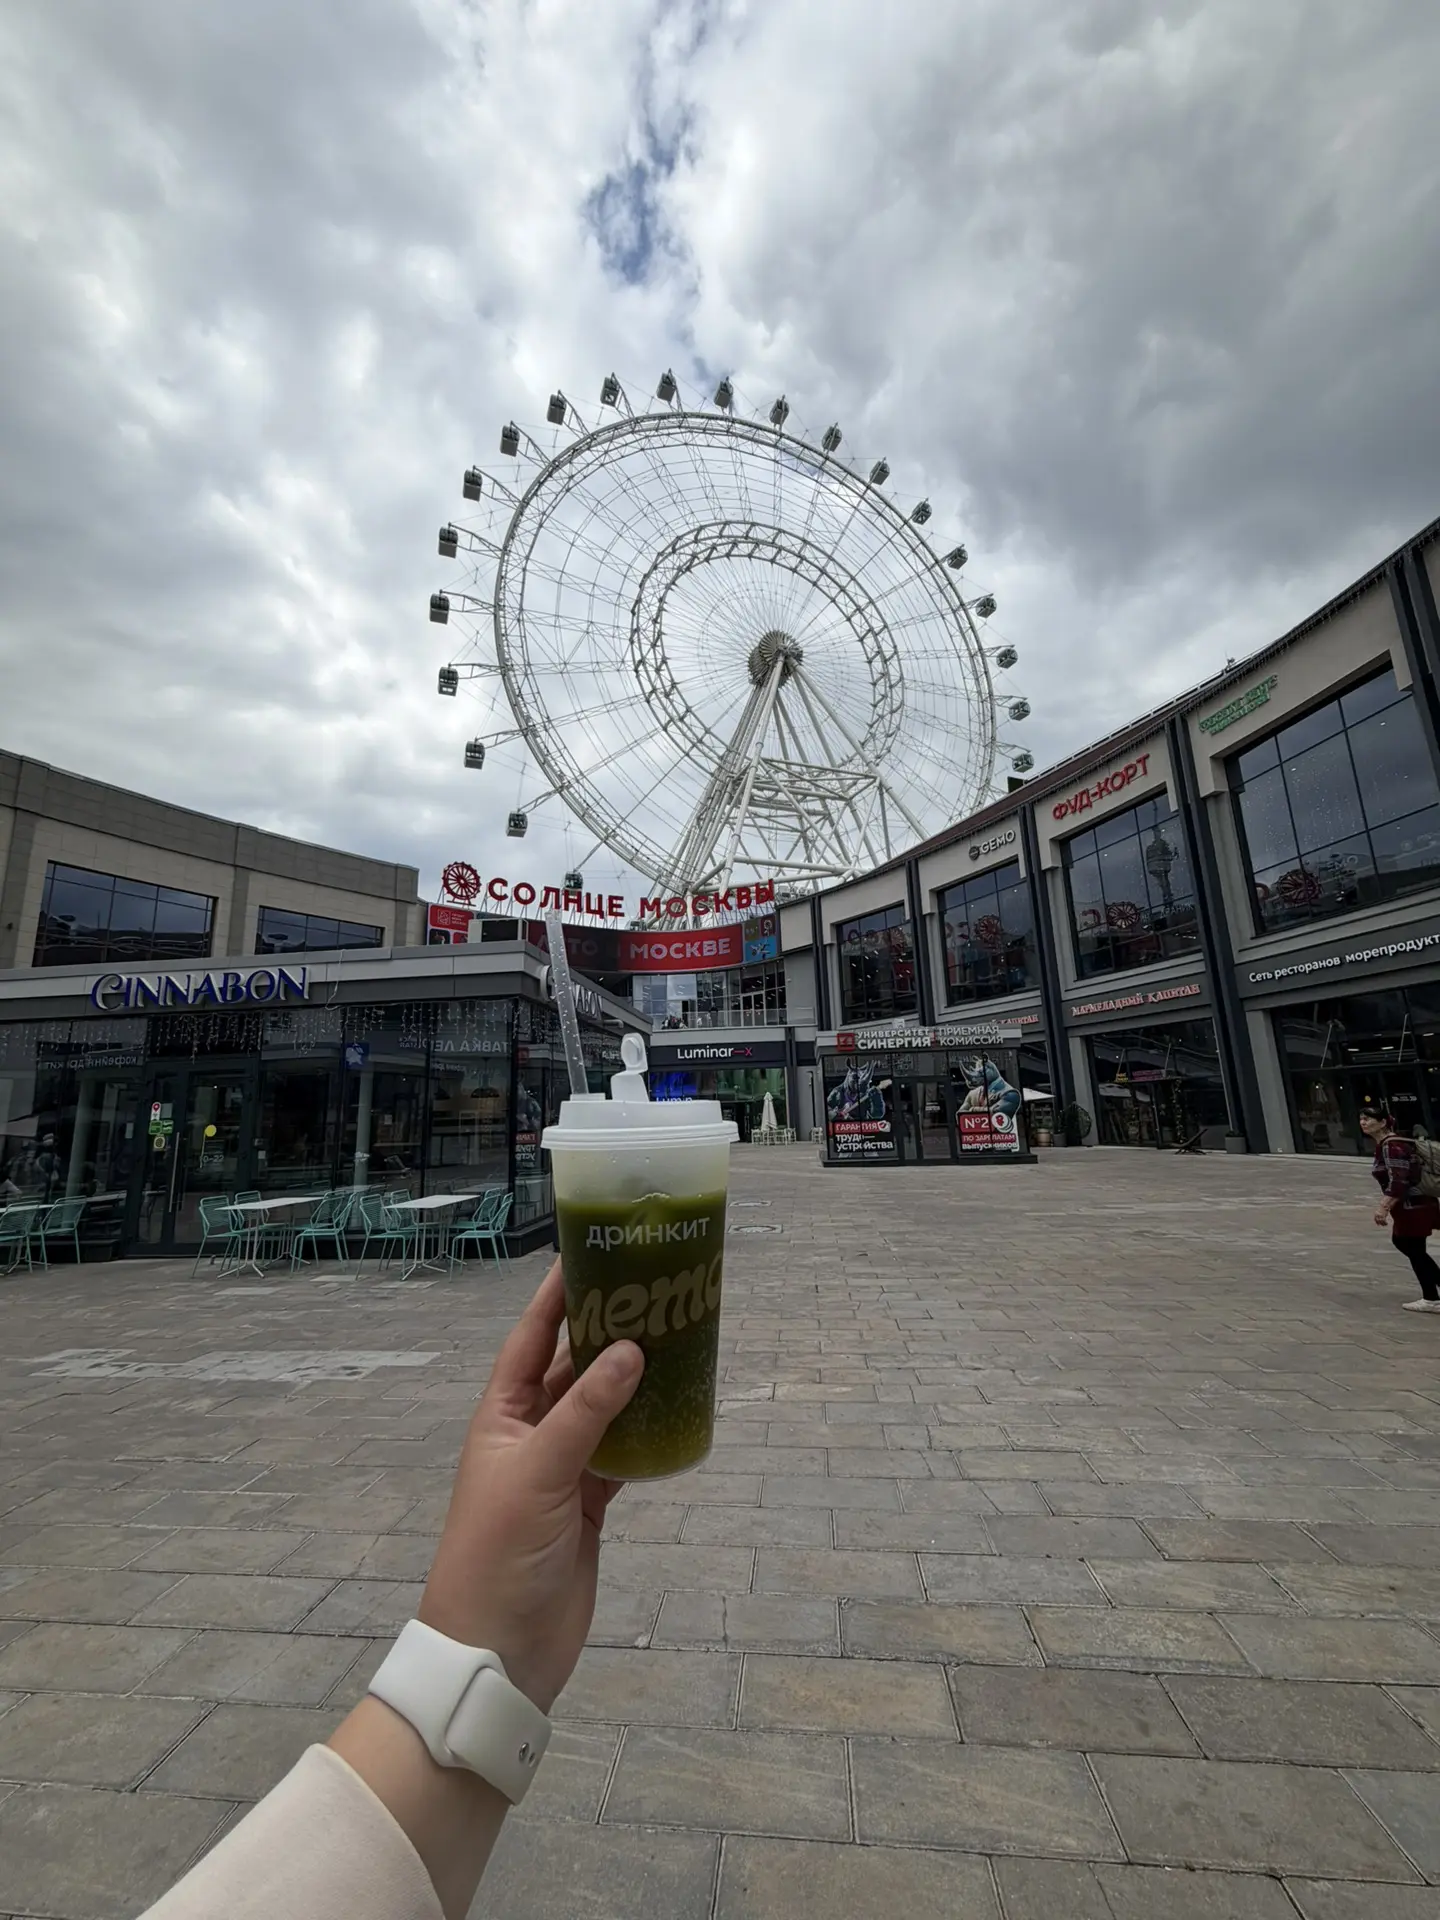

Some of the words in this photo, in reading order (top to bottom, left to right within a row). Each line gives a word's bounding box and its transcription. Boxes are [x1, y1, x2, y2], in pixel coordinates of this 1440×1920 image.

[1052, 753, 1150, 820] ФУД-КОРТ
[980, 829, 1016, 854] GEMO
[487, 877, 625, 919] СОЛНЦЕ
[639, 878, 775, 919] МОСКВЫ
[630, 937, 731, 960] МОСКВЕ
[1249, 971, 1273, 983] Сеть
[1274, 956, 1341, 980] ресторанов
[91, 966, 310, 1011] CINNABON
[857, 1028, 930, 1039] УНИВЕРСИТЕТ
[938, 1025, 1000, 1036] ПРИЕМНАЯ
[939, 1034, 1004, 1047] КОМИССИЯ
[857, 1037, 931, 1050] СИНЕРГИЯ
[586, 1217, 711, 1251] дринкит
